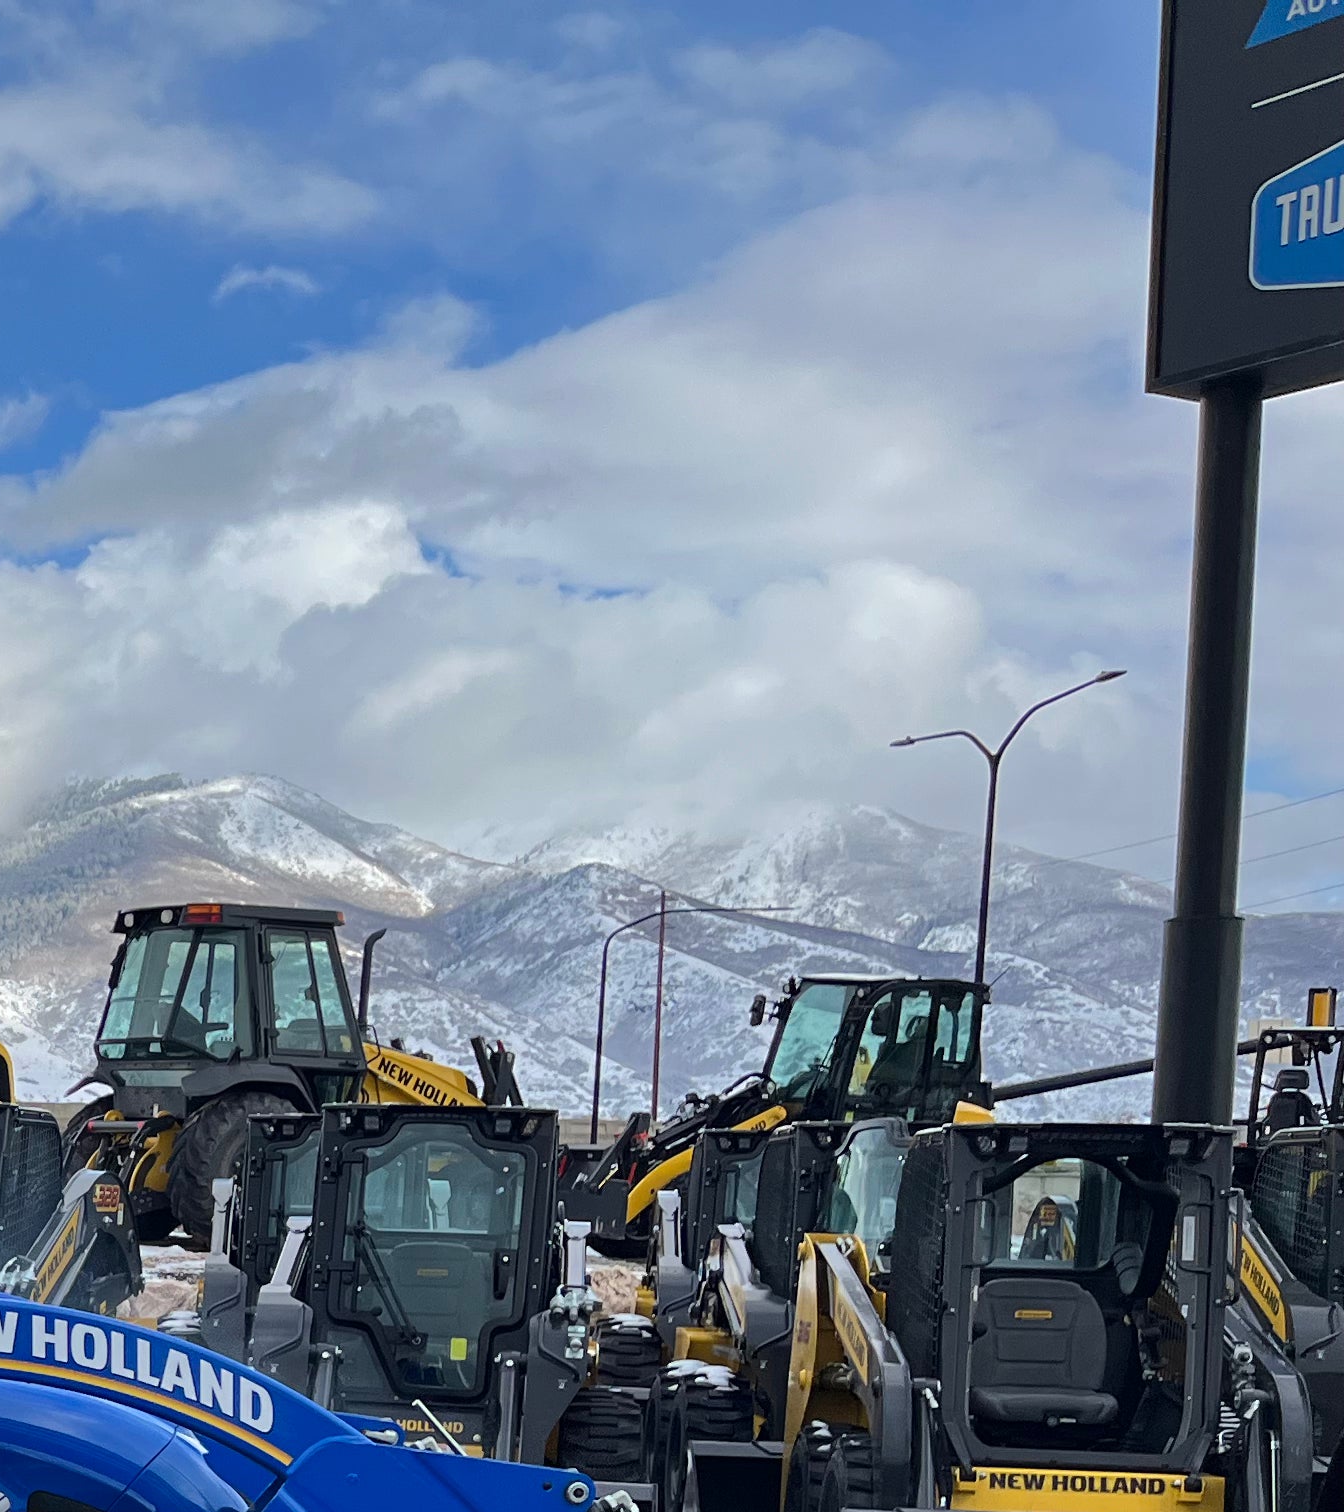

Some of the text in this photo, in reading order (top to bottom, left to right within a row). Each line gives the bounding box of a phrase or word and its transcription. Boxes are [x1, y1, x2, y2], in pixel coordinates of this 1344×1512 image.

[1275, 174, 1344, 246] TRU
[377, 1056, 465, 1107] NEW HOLLA
[31, 1314, 274, 1434] HOLLAND
[396, 1419, 464, 1434] HOLLND
[989, 1472, 1166, 1495] NEW HOLLAND
